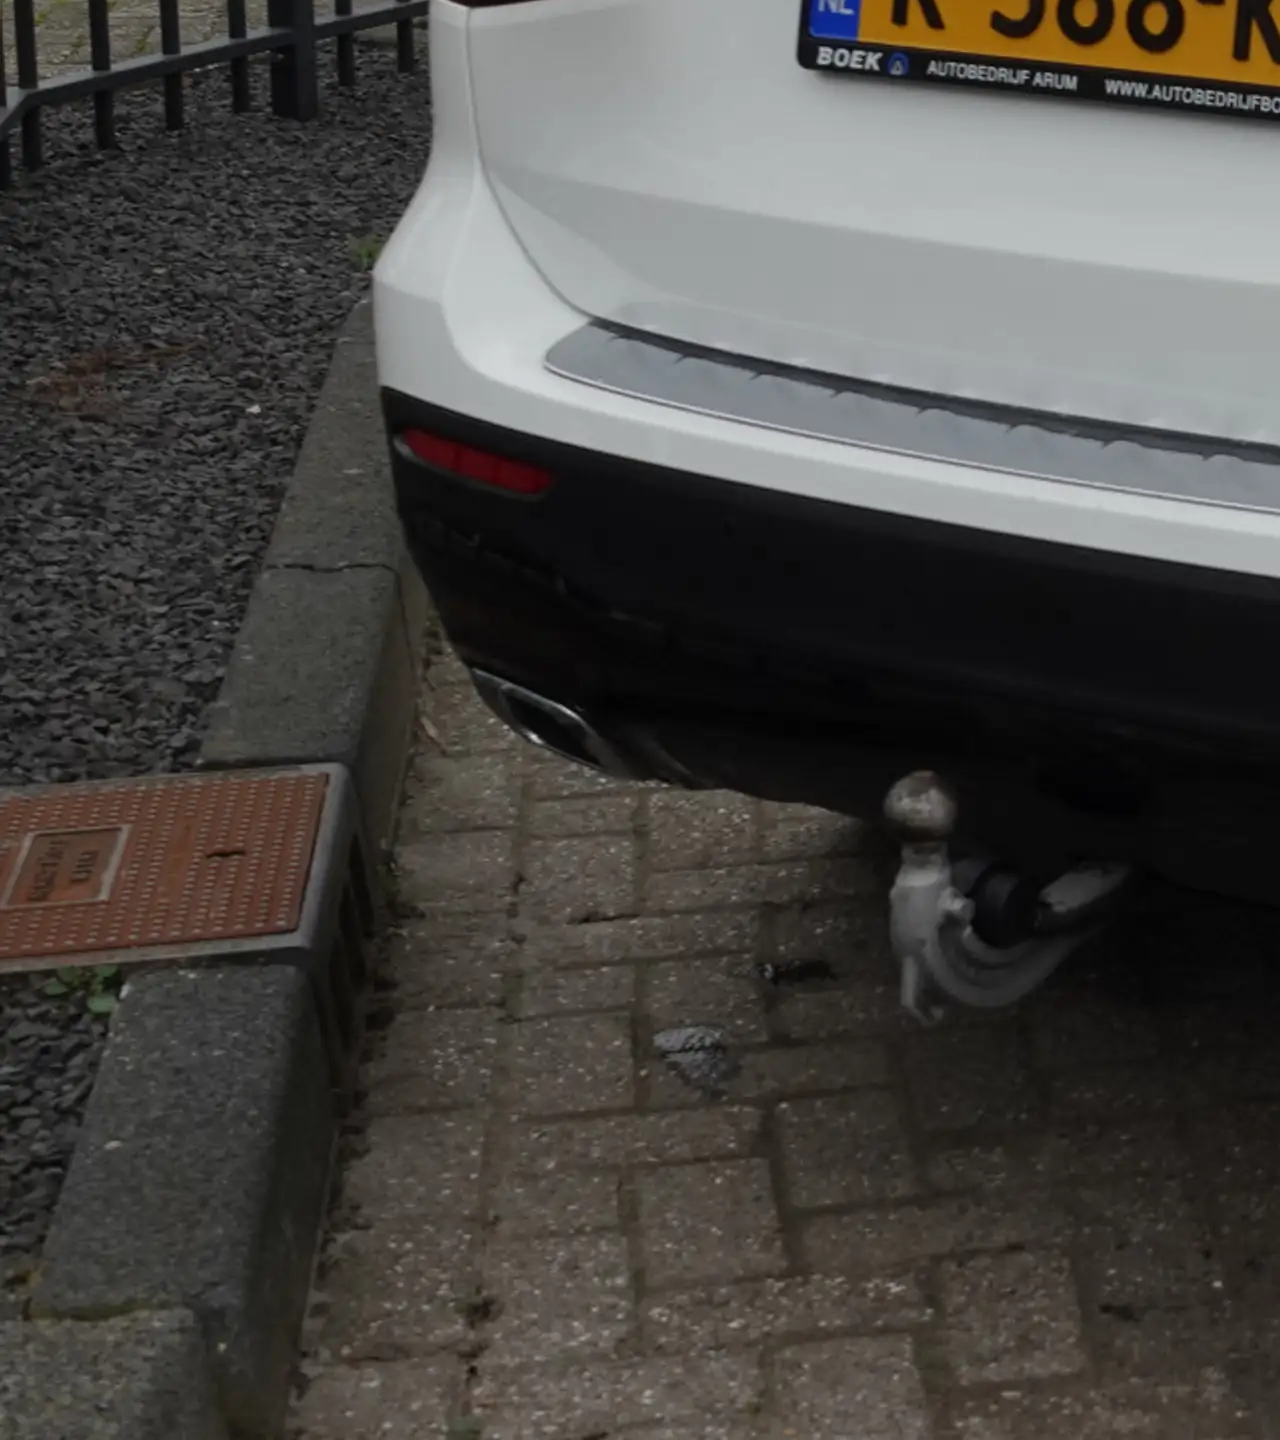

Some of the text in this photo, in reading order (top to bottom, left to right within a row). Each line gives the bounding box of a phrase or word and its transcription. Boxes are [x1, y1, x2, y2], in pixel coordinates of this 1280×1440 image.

[816, 45, 884, 72] BOEK
[926, 59, 1079, 92] AUTOBEDRIJF ARUM
